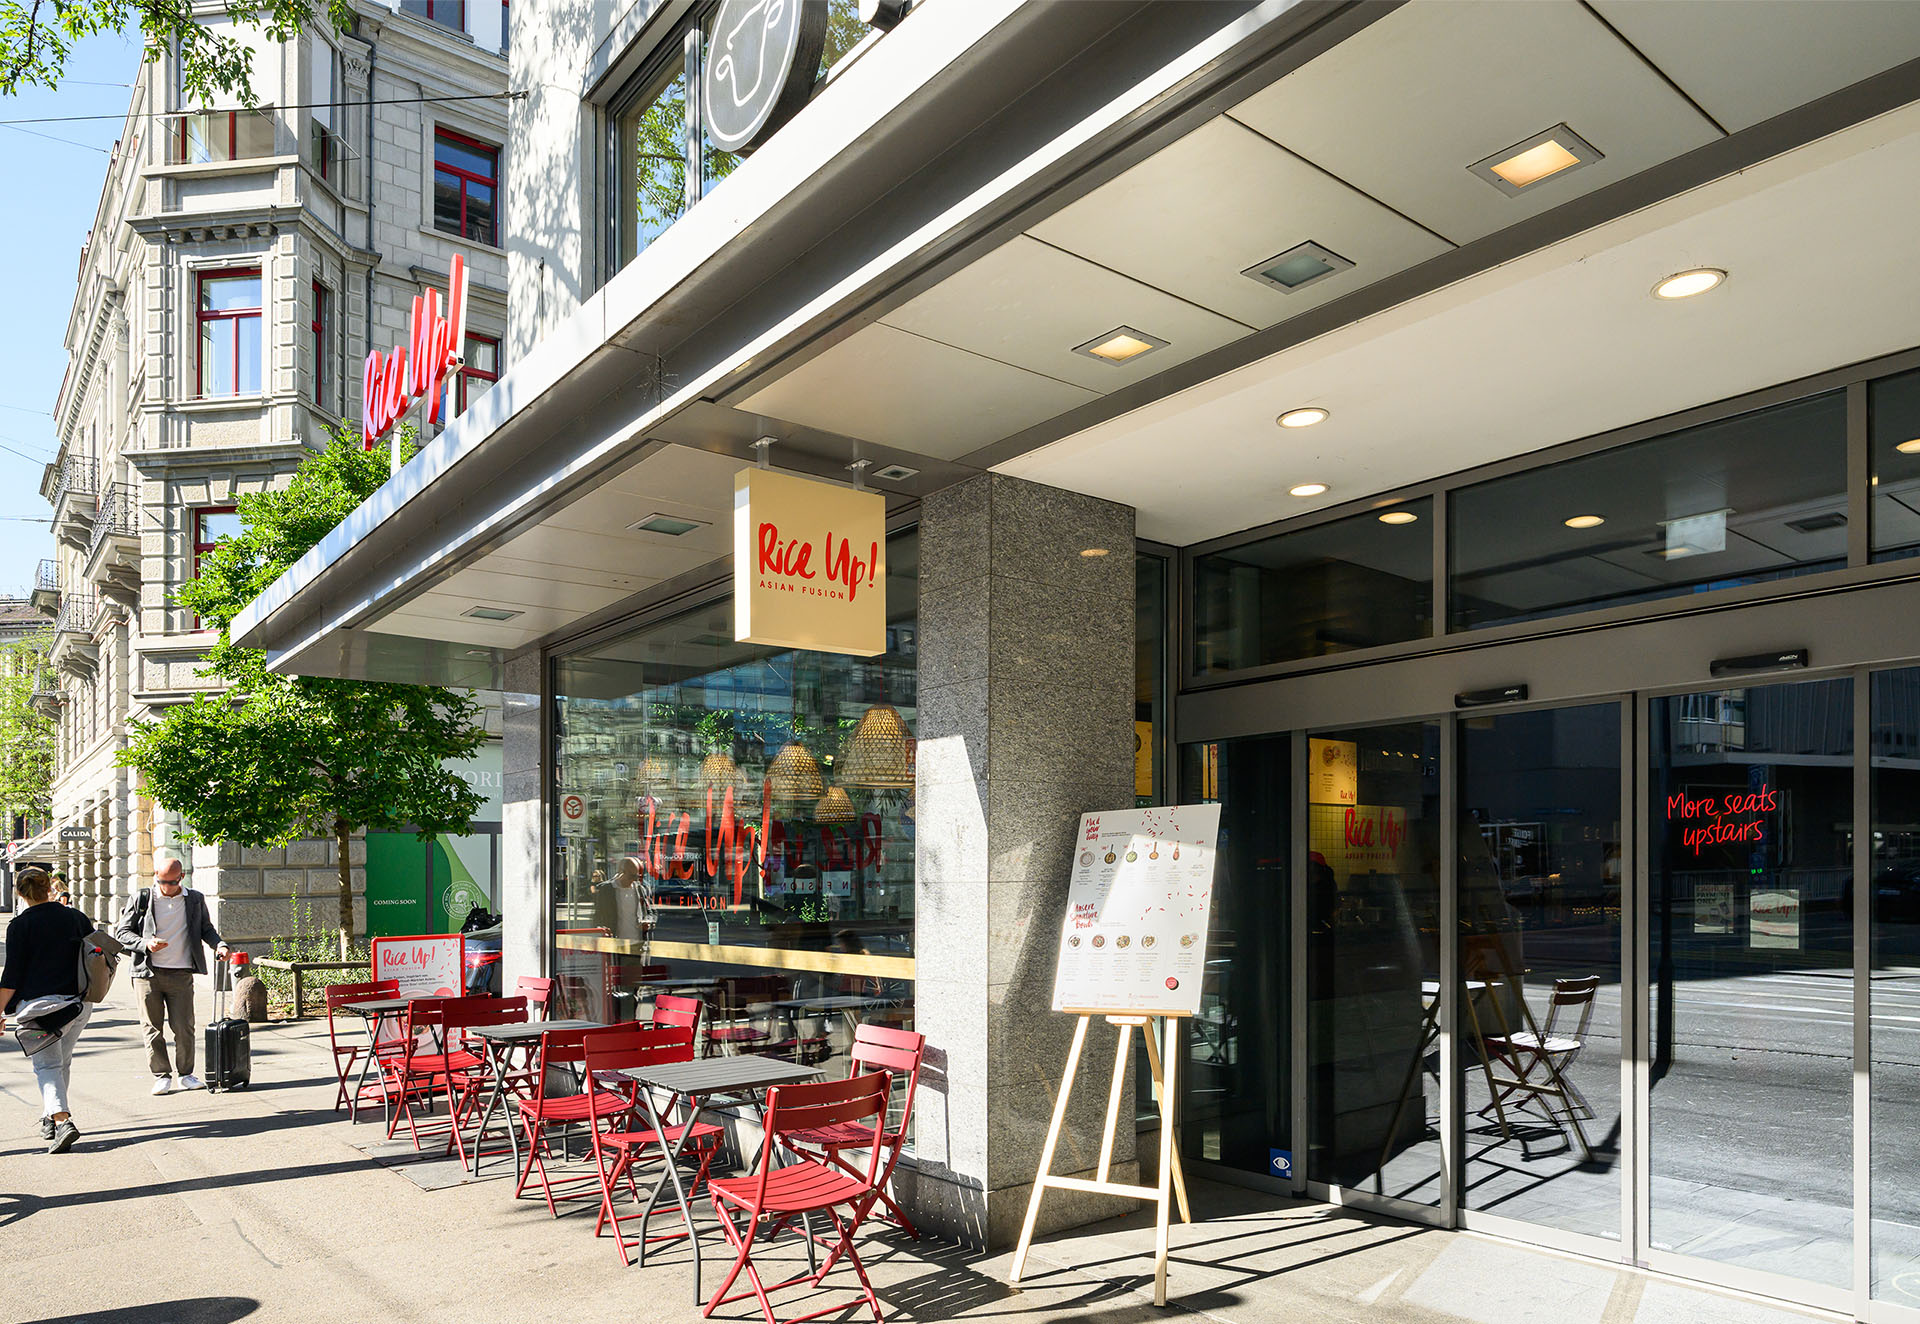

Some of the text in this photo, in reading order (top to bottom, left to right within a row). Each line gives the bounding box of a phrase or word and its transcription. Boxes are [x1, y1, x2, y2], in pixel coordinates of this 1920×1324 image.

[758, 522, 877, 603] Rice Up!
[759, 579, 844, 600] ASIAN FUSION
[1667, 784, 1777, 820] More seats
[706, 777, 772, 914] Up!
[1345, 808, 1407, 858] Rice Up!
[1683, 816, 1764, 856] upstairs
[679, 896, 727, 910] FUSION
[383, 945, 435, 970] Rice Up!
